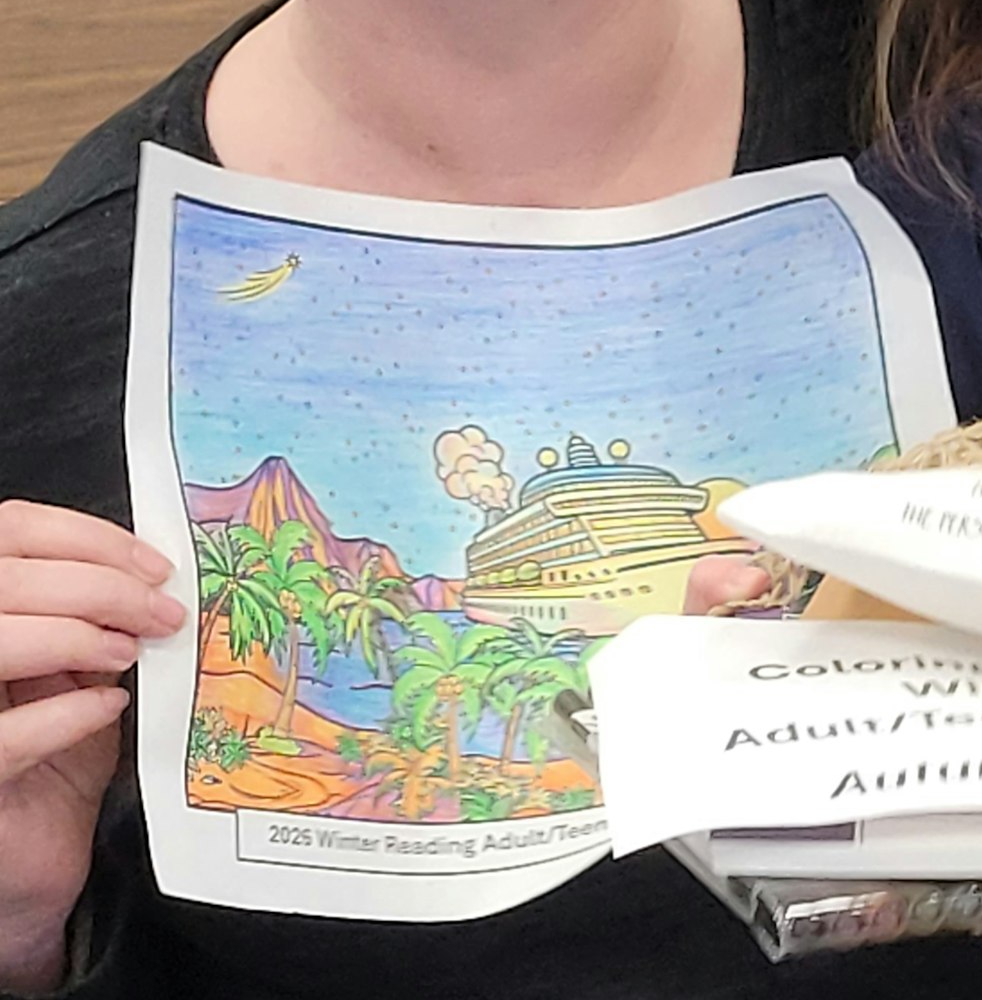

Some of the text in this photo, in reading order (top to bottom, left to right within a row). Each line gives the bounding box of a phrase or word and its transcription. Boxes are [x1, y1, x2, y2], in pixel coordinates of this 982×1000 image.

[315, 829, 380, 852] Winter
[384, 835, 477, 859] Reading
[482, 819, 608, 852] Adult/Teen
